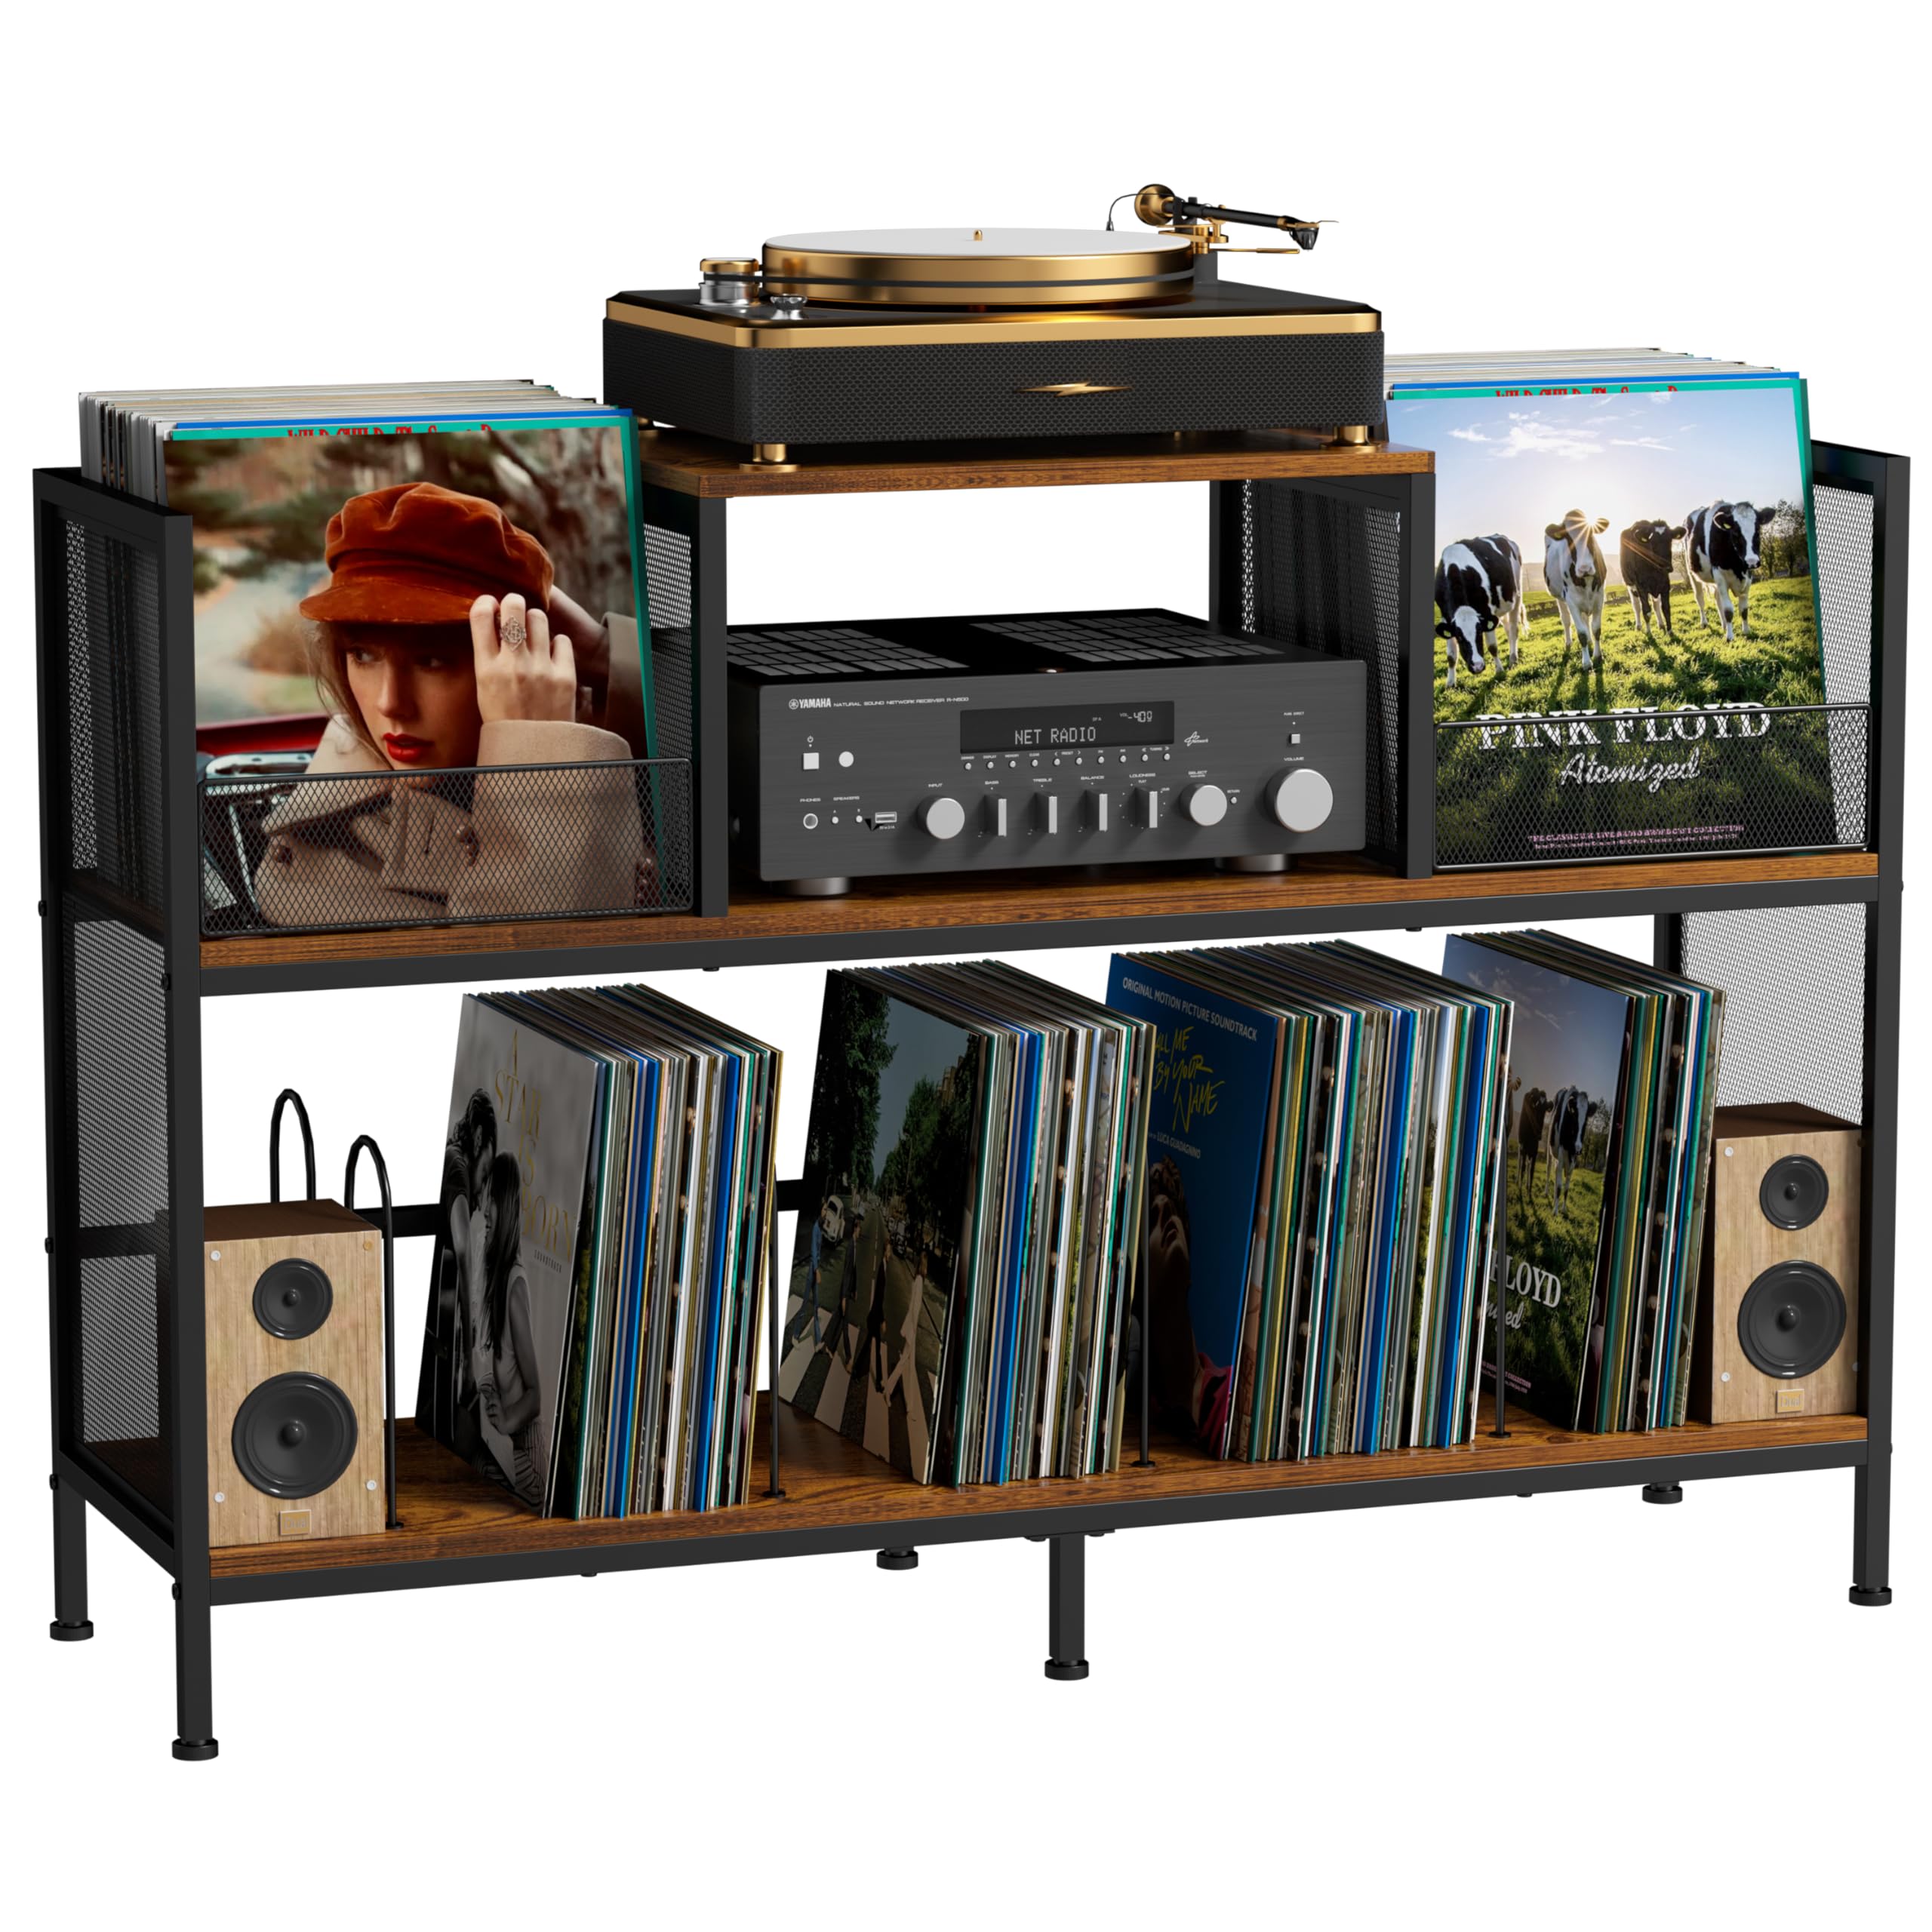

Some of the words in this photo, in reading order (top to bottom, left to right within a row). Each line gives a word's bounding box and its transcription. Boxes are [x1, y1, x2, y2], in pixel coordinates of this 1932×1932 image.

[798, 697, 832, 709] YAMAHA
[1475, 709, 1601, 750] PINK
[1610, 703, 1771, 743] FLOYD
[1014, 729, 1042, 745] NET
[1051, 727, 1096, 743] RADIO
[1559, 746, 1701, 793] Atomized
[1122, 977, 1153, 999] ORIGINAL
[1154, 989, 1181, 1010] MOTION
[1181, 1001, 1210, 1022] PICTURE
[1211, 1011, 1258, 1041] SOUNDTRACK
[494, 1067, 542, 1140] STAR
[1172, 1080, 1226, 1134] NAME
[521, 1186, 576, 1263] BORN
